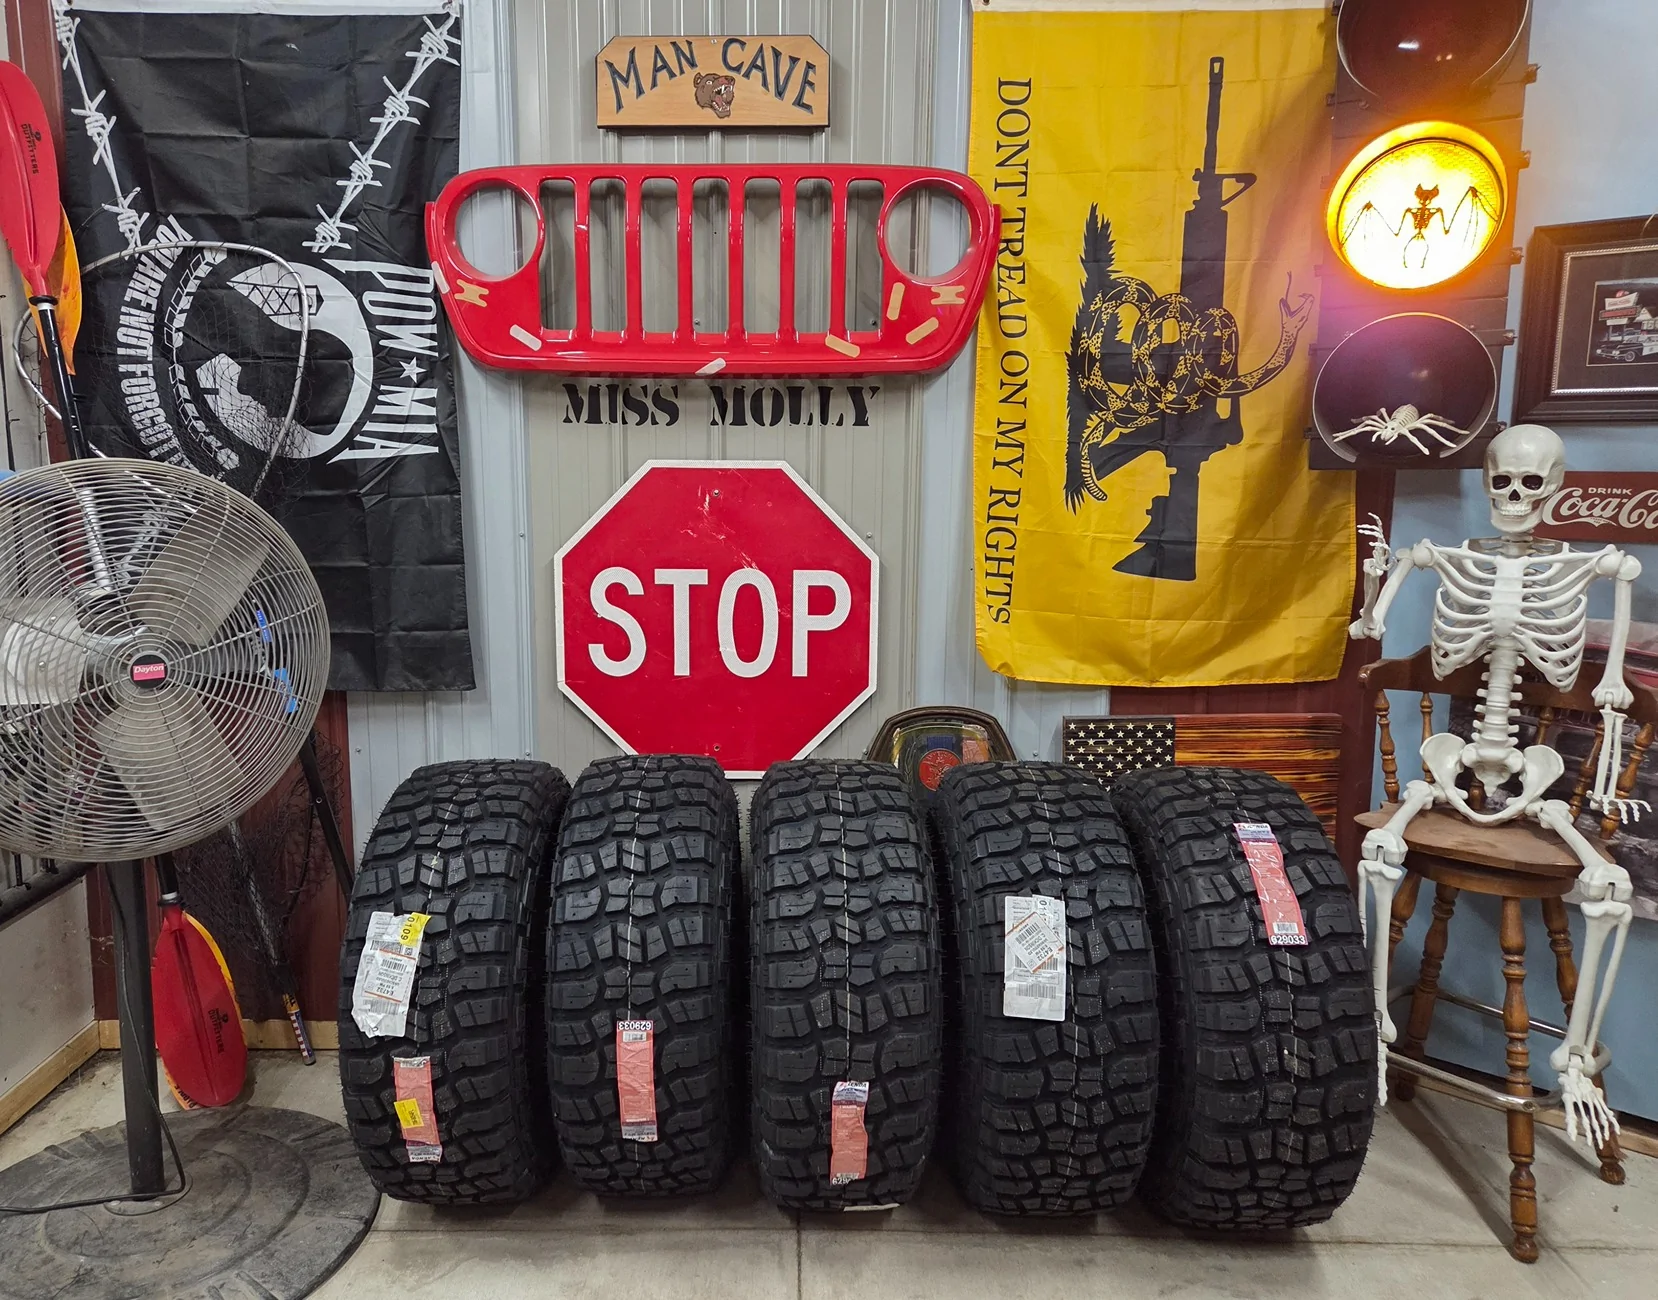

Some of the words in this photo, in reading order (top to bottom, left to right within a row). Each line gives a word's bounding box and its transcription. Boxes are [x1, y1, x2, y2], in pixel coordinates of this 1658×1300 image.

[604, 39, 699, 115] MAN
[721, 37, 817, 114] CAVE
[20, 123, 40, 176] OUTFITTERS
[992, 77, 1033, 198] DONT
[147, 214, 193, 270] YOU
[125, 254, 167, 312] ARE
[996, 206, 1030, 340] TREAD
[117, 307, 156, 356] NOT
[321, 258, 439, 358] POW
[561, 383, 680, 427] MISS
[708, 384, 881, 428] MOLLY
[998, 349, 1031, 409] ON
[325, 384, 440, 465] MIA
[991, 418, 1028, 479] MY
[1587, 487, 1632, 495] DRINK
[983, 485, 1024, 625] RIGHTS
[587, 565, 853, 679] STOP
[133, 665, 165, 675] Dayton
[399, 915, 416, 942] 0109
[1270, 933, 1306, 946] 629033
[208, 1009, 226, 1055] OUTFITTERS
[618, 1020, 652, 1031] 629033
